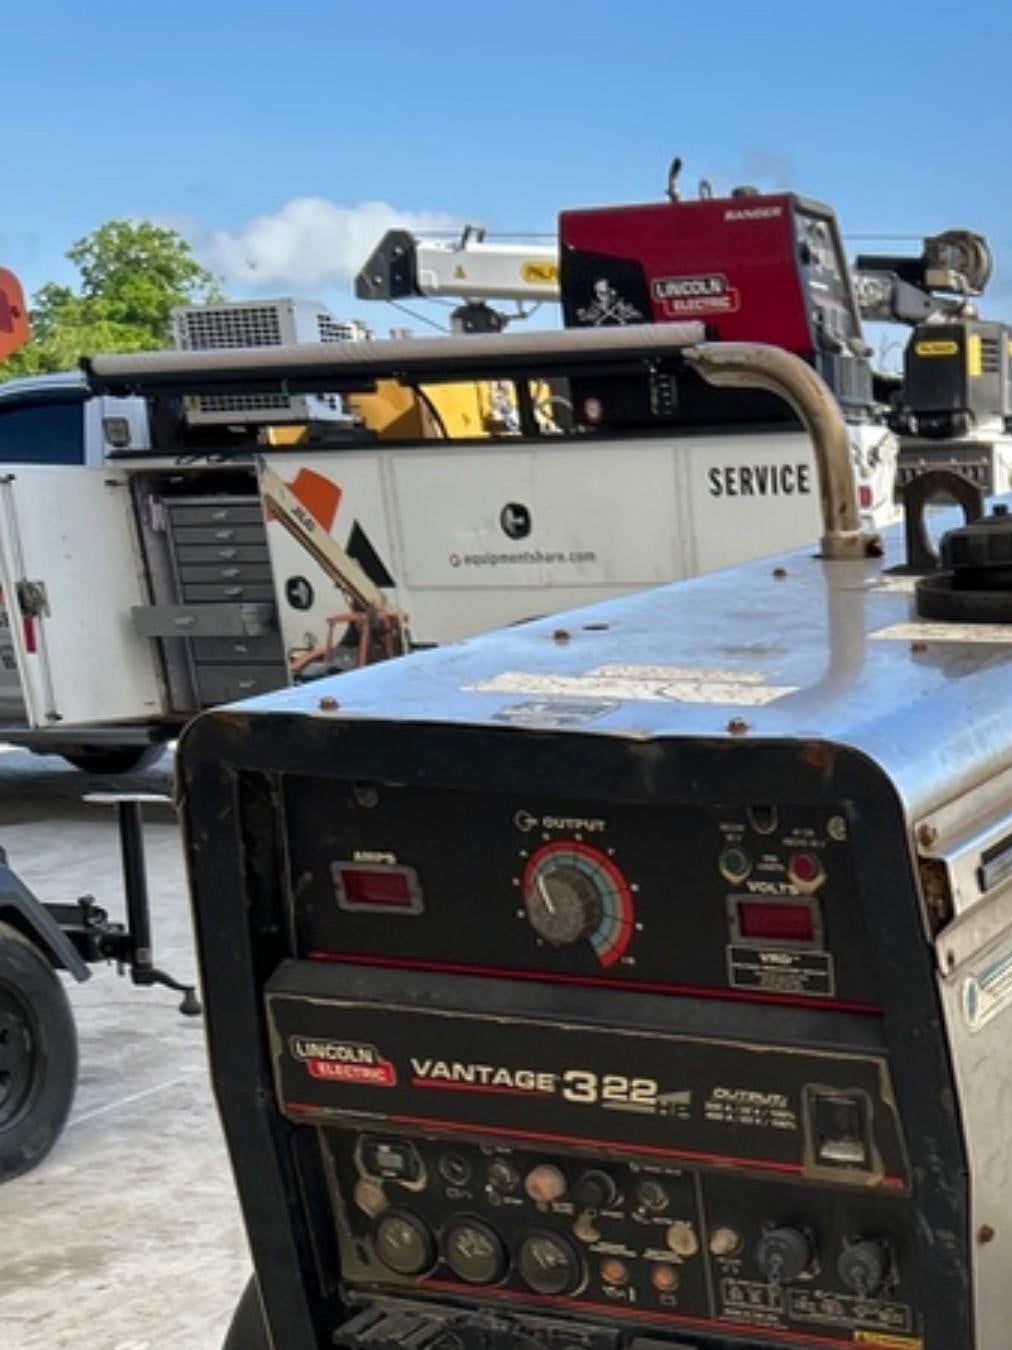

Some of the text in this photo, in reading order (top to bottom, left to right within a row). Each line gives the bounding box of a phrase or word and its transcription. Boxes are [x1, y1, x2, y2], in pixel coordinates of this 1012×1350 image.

[723, 206, 784, 221] RANGER
[655, 278, 722, 299] LINCOLN
[671, 296, 731, 312] ELECTRIC
[708, 463, 811, 498] SERVICE
[541, 815, 607, 832] OUTPUT
[295, 1040, 375, 1064] LINCOLN
[317, 1061, 388, 1083] ELECTRIC
[409, 1057, 659, 1105] VANTAGE 322
